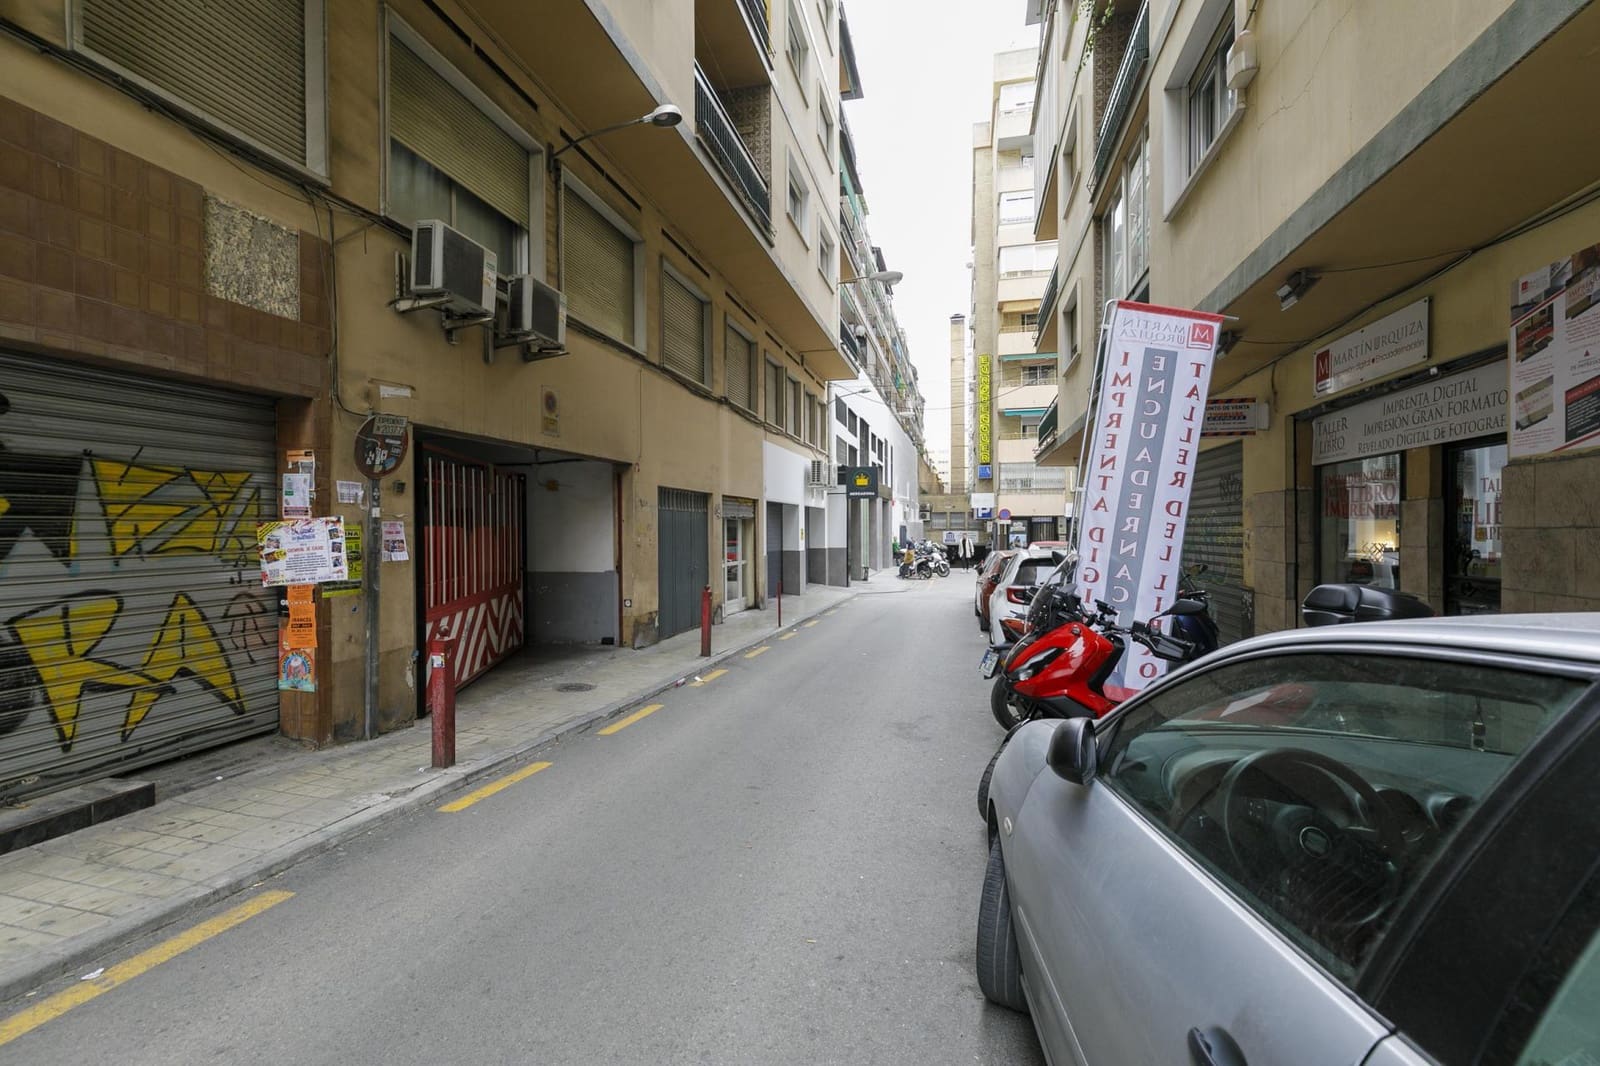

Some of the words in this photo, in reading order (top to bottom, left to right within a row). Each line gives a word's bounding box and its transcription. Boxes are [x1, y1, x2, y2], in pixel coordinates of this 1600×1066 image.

[1383, 392, 1429, 416] IMPRENTA
[1433, 378, 1478, 402] DIGITAL
[1317, 417, 1348, 436] TALLER
[1363, 414, 1409, 437] IMPRESIÓN
[1411, 407, 1443, 425] GRAN
[1448, 389, 1508, 417] FORMATO
[1318, 436, 1345, 454] LIBRO
[1358, 438, 1394, 454] REVELADO
[1397, 430, 1429, 445] DIGITAL
[1433, 427, 1446, 439] DE
